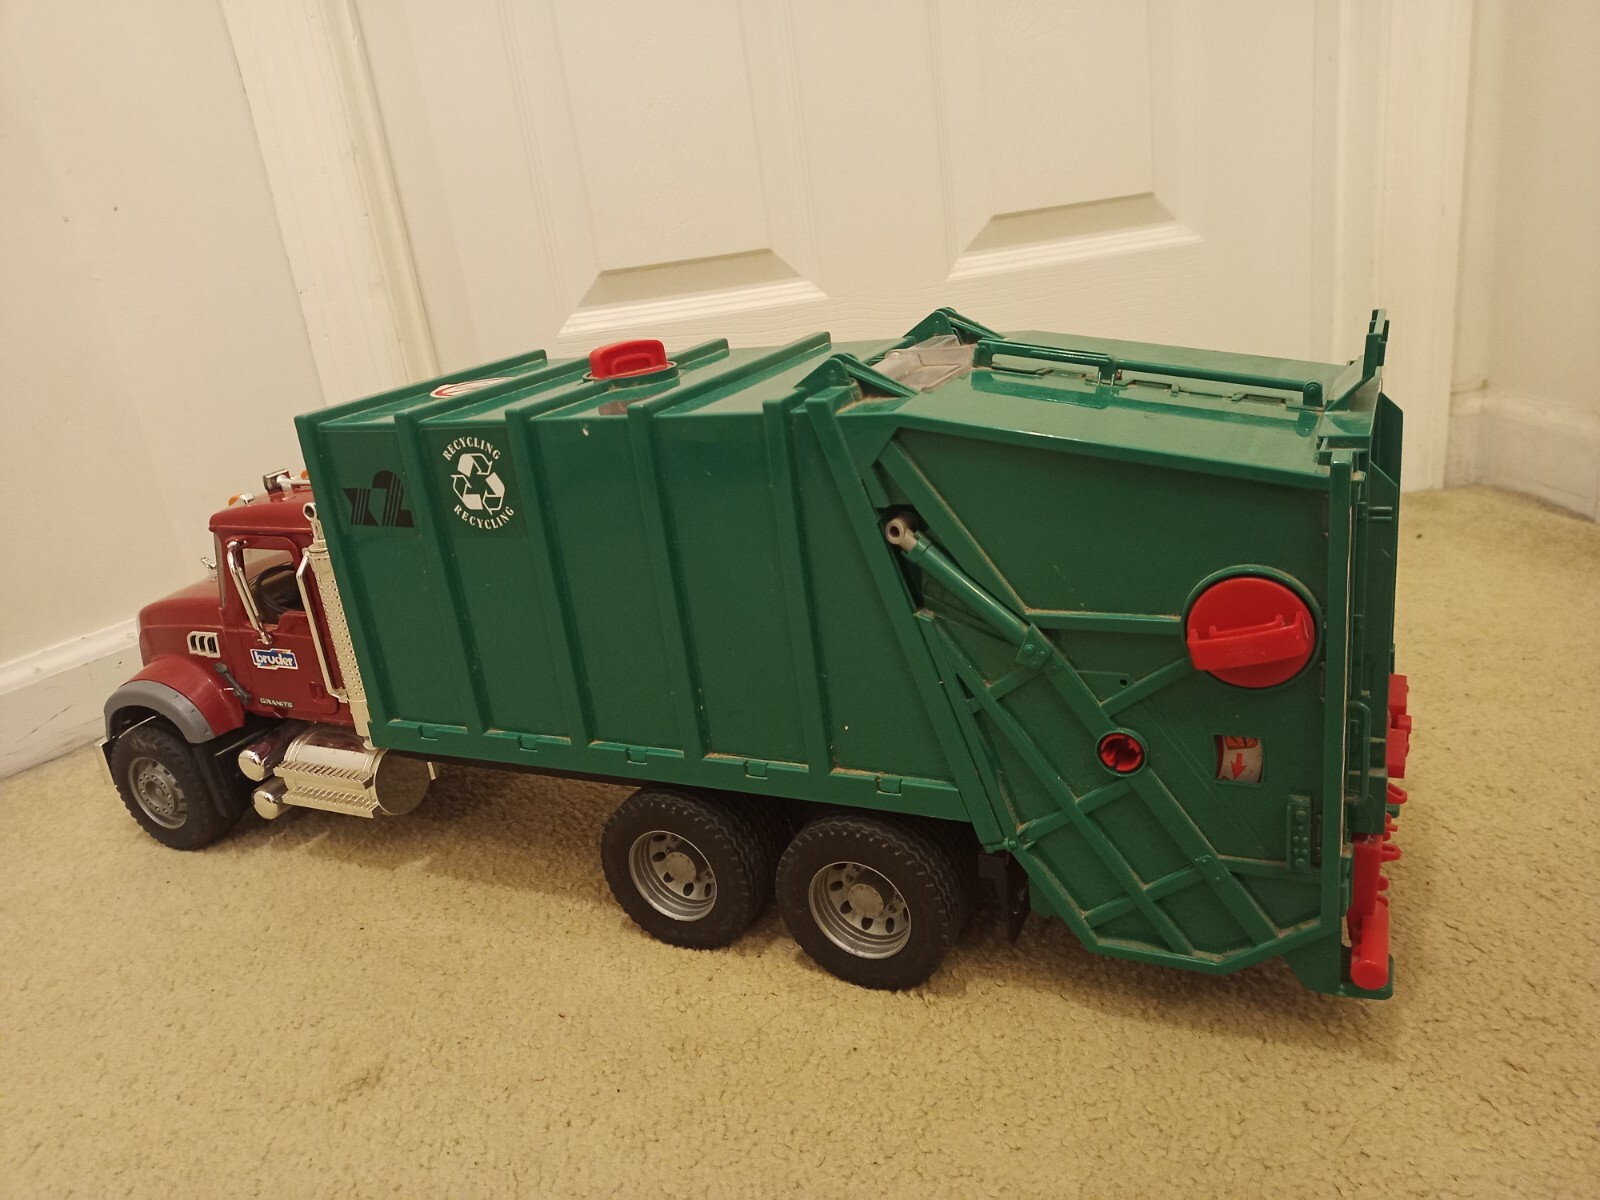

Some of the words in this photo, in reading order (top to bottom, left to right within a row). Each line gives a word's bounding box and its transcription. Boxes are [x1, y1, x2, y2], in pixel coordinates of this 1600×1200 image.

[442, 437, 500, 461] RECYCLING
[453, 504, 514, 529] RECYCLING
[254, 650, 293, 666] bruder
[259, 697, 293, 708] GRANITE
